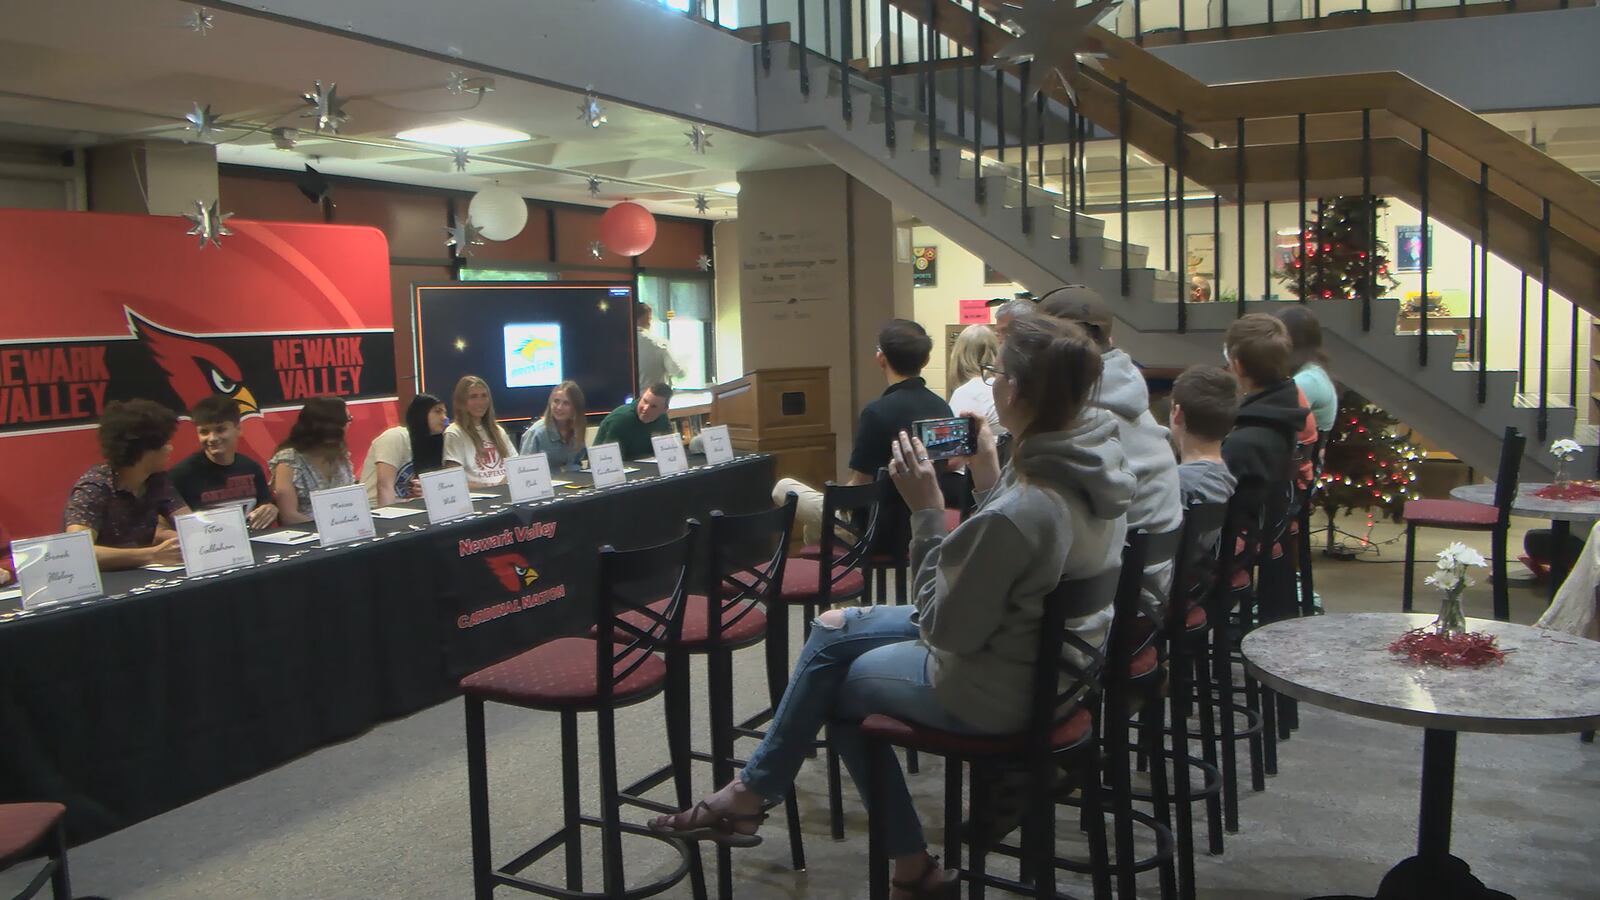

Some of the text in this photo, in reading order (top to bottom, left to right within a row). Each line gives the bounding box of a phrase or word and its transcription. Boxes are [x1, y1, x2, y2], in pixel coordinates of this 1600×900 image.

[0, 346, 110, 385] EWARK
[273, 337, 364, 369] NEWARK
[279, 366, 362, 400] VALLEY
[458, 521, 557, 557] Newark Valley
[457, 584, 566, 629] CARDINAL NATION
